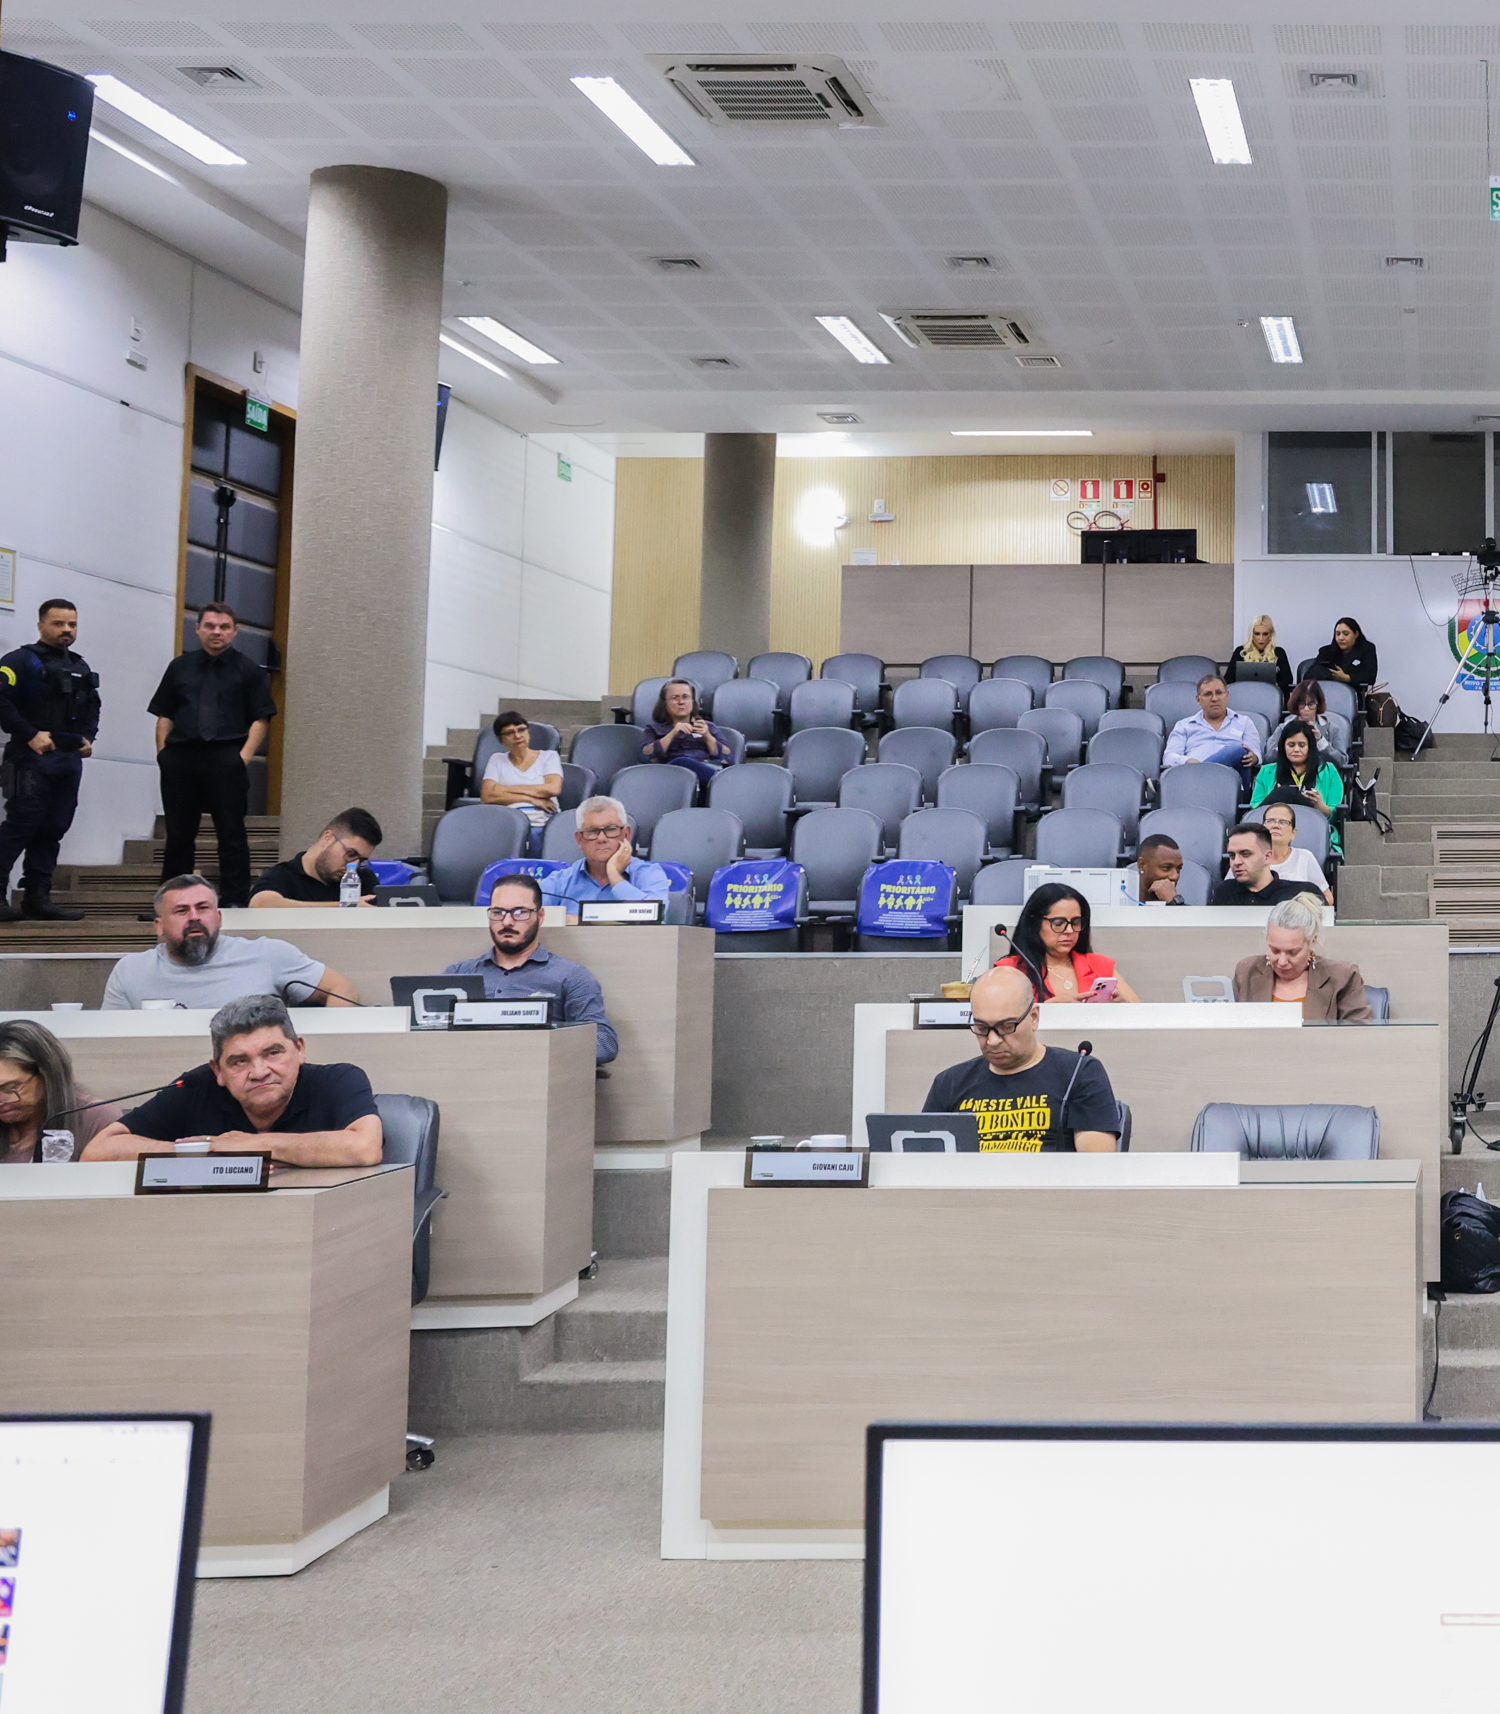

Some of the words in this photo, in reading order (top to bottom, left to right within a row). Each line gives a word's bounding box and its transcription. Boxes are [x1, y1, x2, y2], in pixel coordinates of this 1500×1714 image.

[1016, 1094, 1048, 1109] VALE
[989, 1110, 1046, 1130] BONITO
[213, 1166, 224, 1175] ITO
[225, 1166, 254, 1174] LUCIANO
[812, 1163, 838, 1171] GIOVANI
[838, 1163, 854, 1172] CAJU
